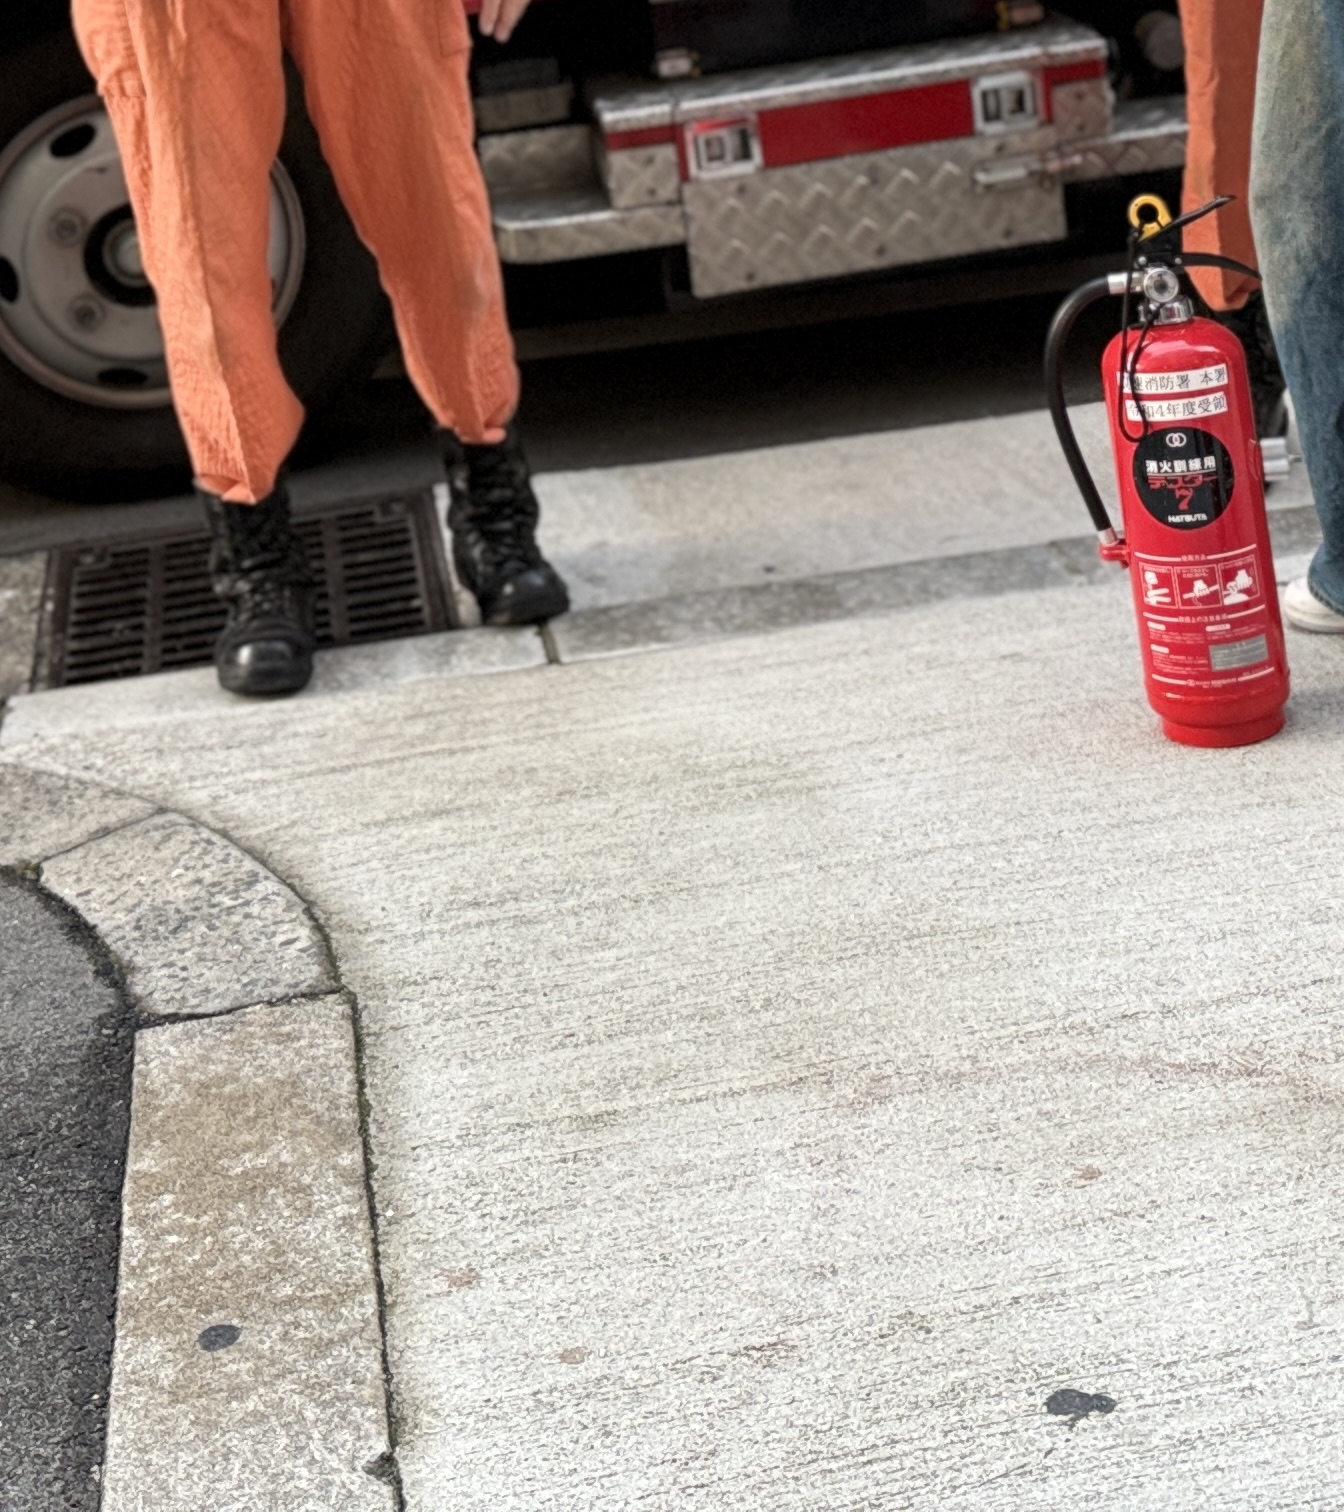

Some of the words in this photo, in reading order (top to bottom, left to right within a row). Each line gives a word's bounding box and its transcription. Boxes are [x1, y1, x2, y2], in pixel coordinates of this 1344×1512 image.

[1146, 456, 1216, 473] 消火訓練用
[1175, 487, 1194, 511] 7
